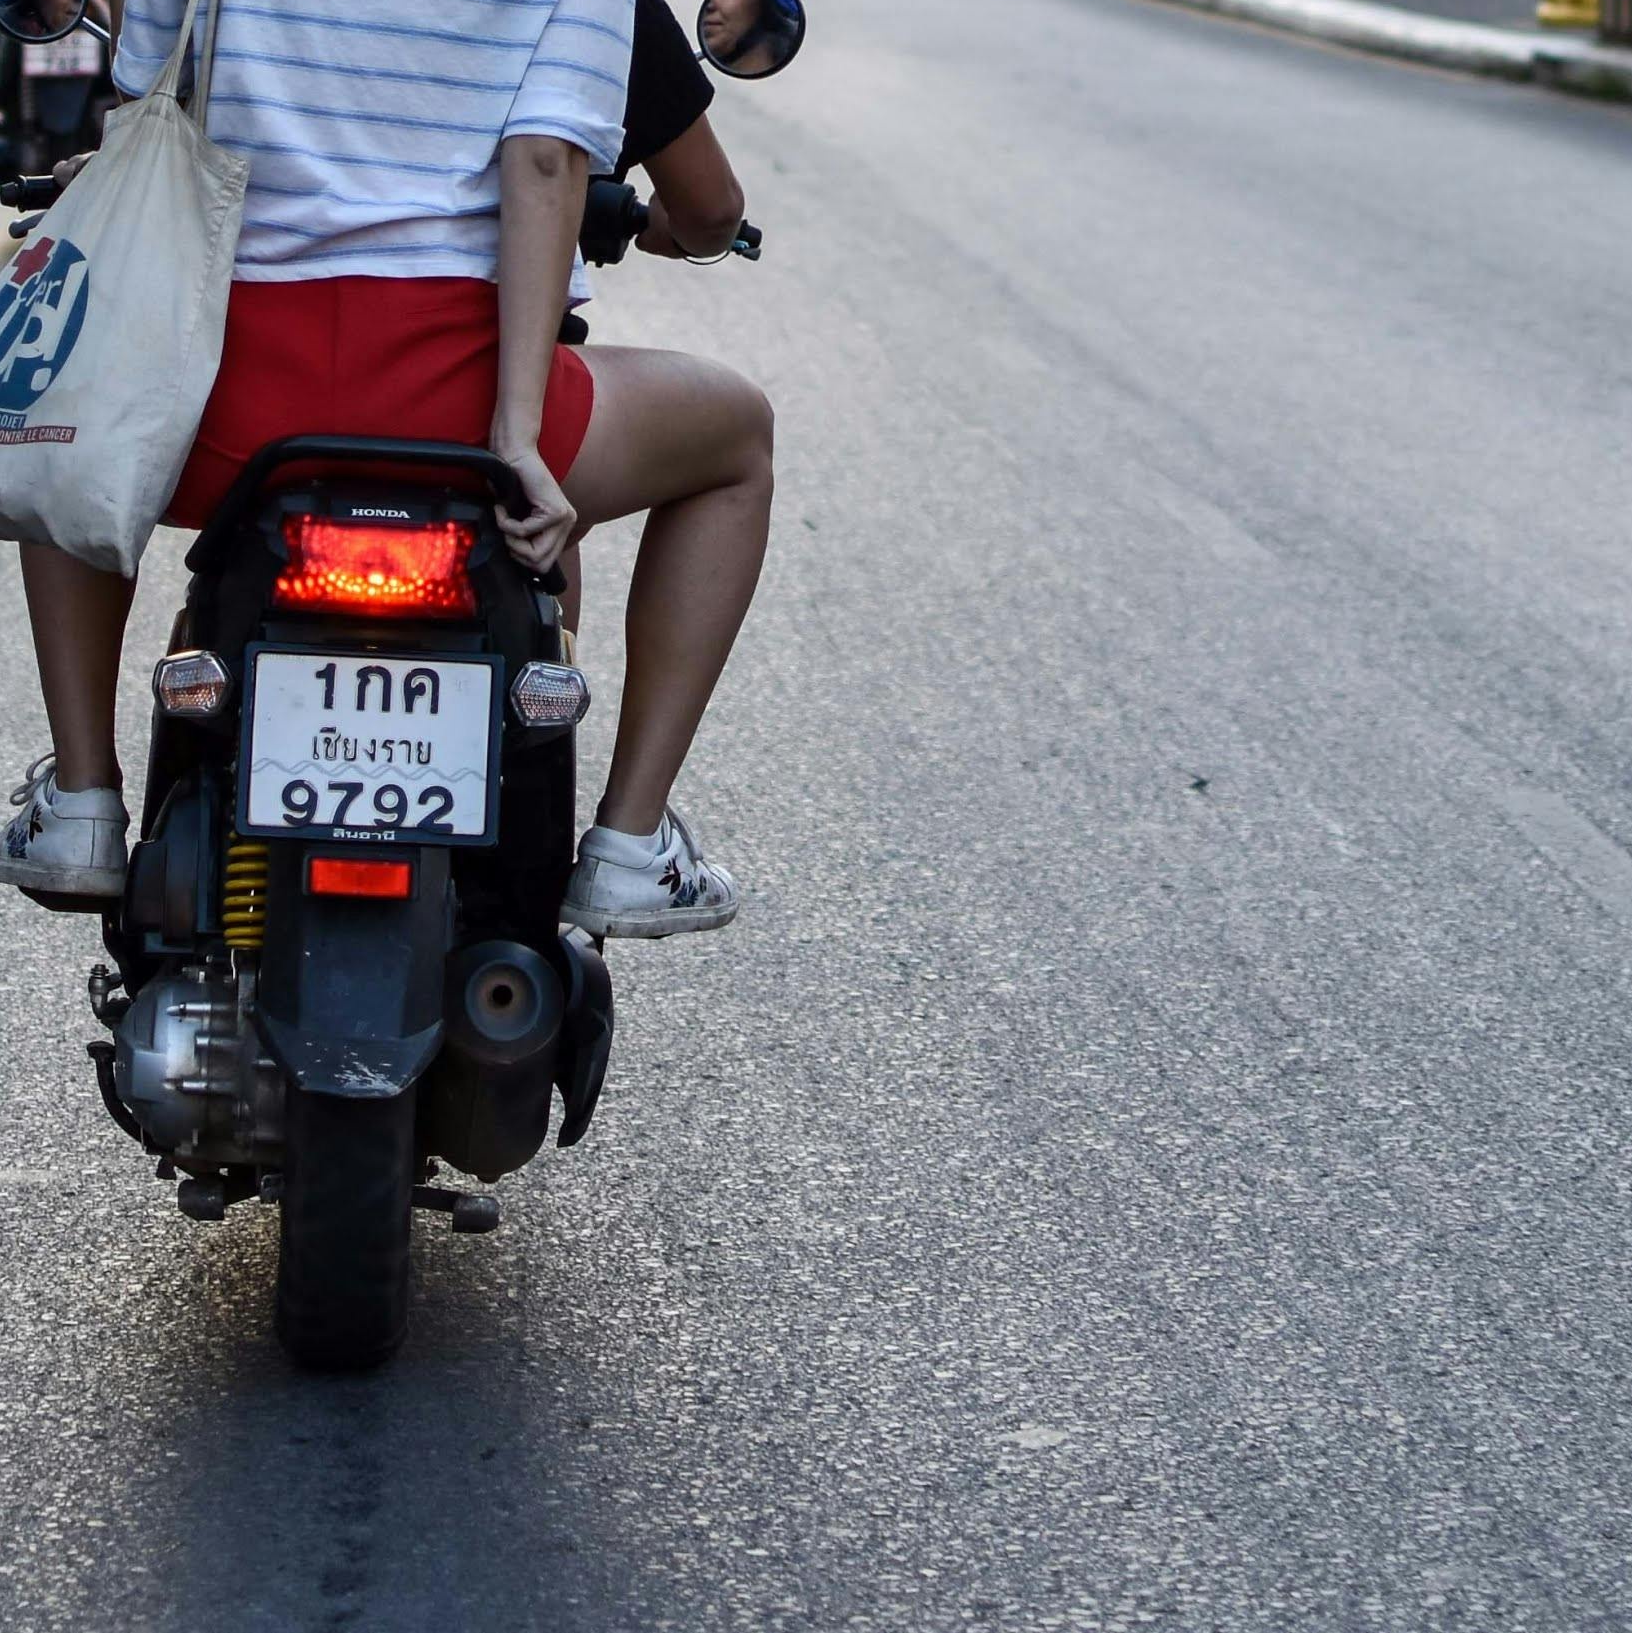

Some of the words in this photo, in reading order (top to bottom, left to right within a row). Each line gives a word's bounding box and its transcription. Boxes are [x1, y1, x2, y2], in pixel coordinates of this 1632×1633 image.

[27, 429, 37, 442] LE
[38, 428, 72, 442] CANCER
[351, 508, 411, 519] HONDA
[315, 662, 440, 714] 1กค
[312, 726, 432, 766] เชียงราย
[281, 779, 454, 834] 9792
